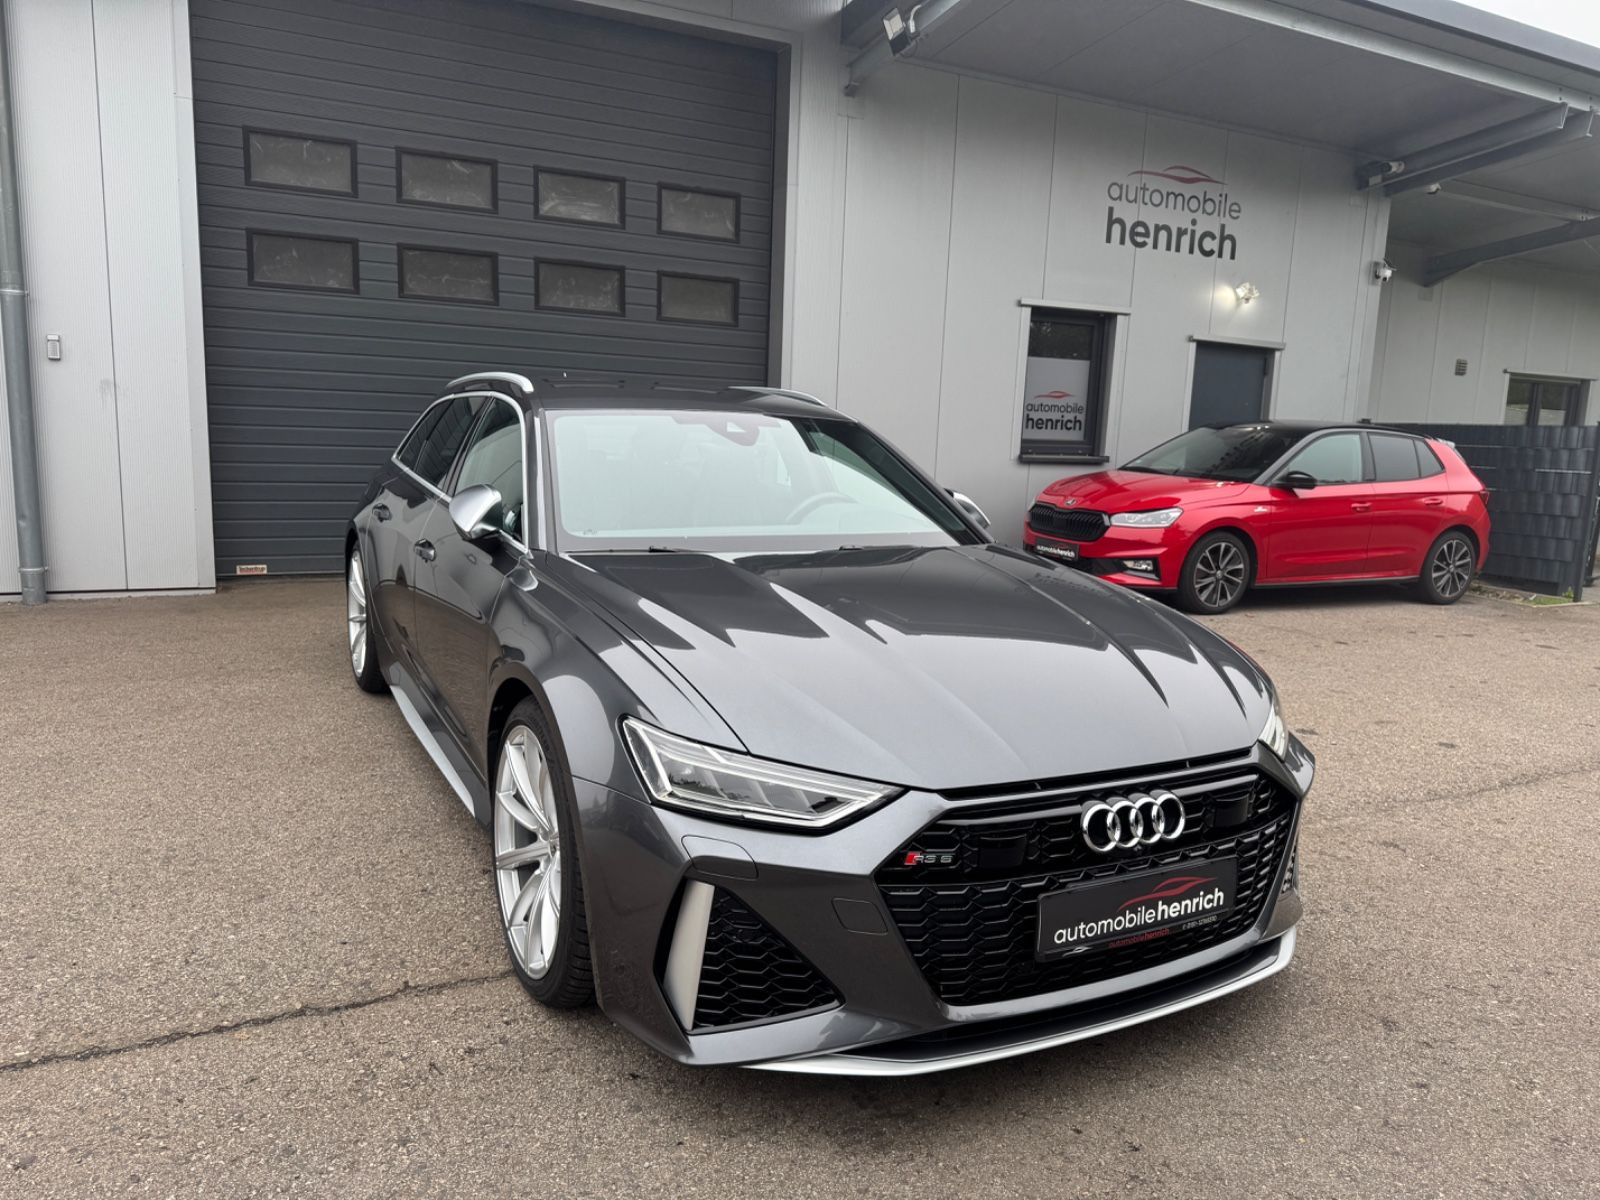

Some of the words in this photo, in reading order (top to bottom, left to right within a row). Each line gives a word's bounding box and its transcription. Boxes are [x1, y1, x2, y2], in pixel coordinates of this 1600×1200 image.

[1107, 182, 1242, 220] automobile
[1105, 206, 1237, 260] henrich
[1025, 402, 1084, 414] automobile
[1025, 413, 1082, 431] henrich
